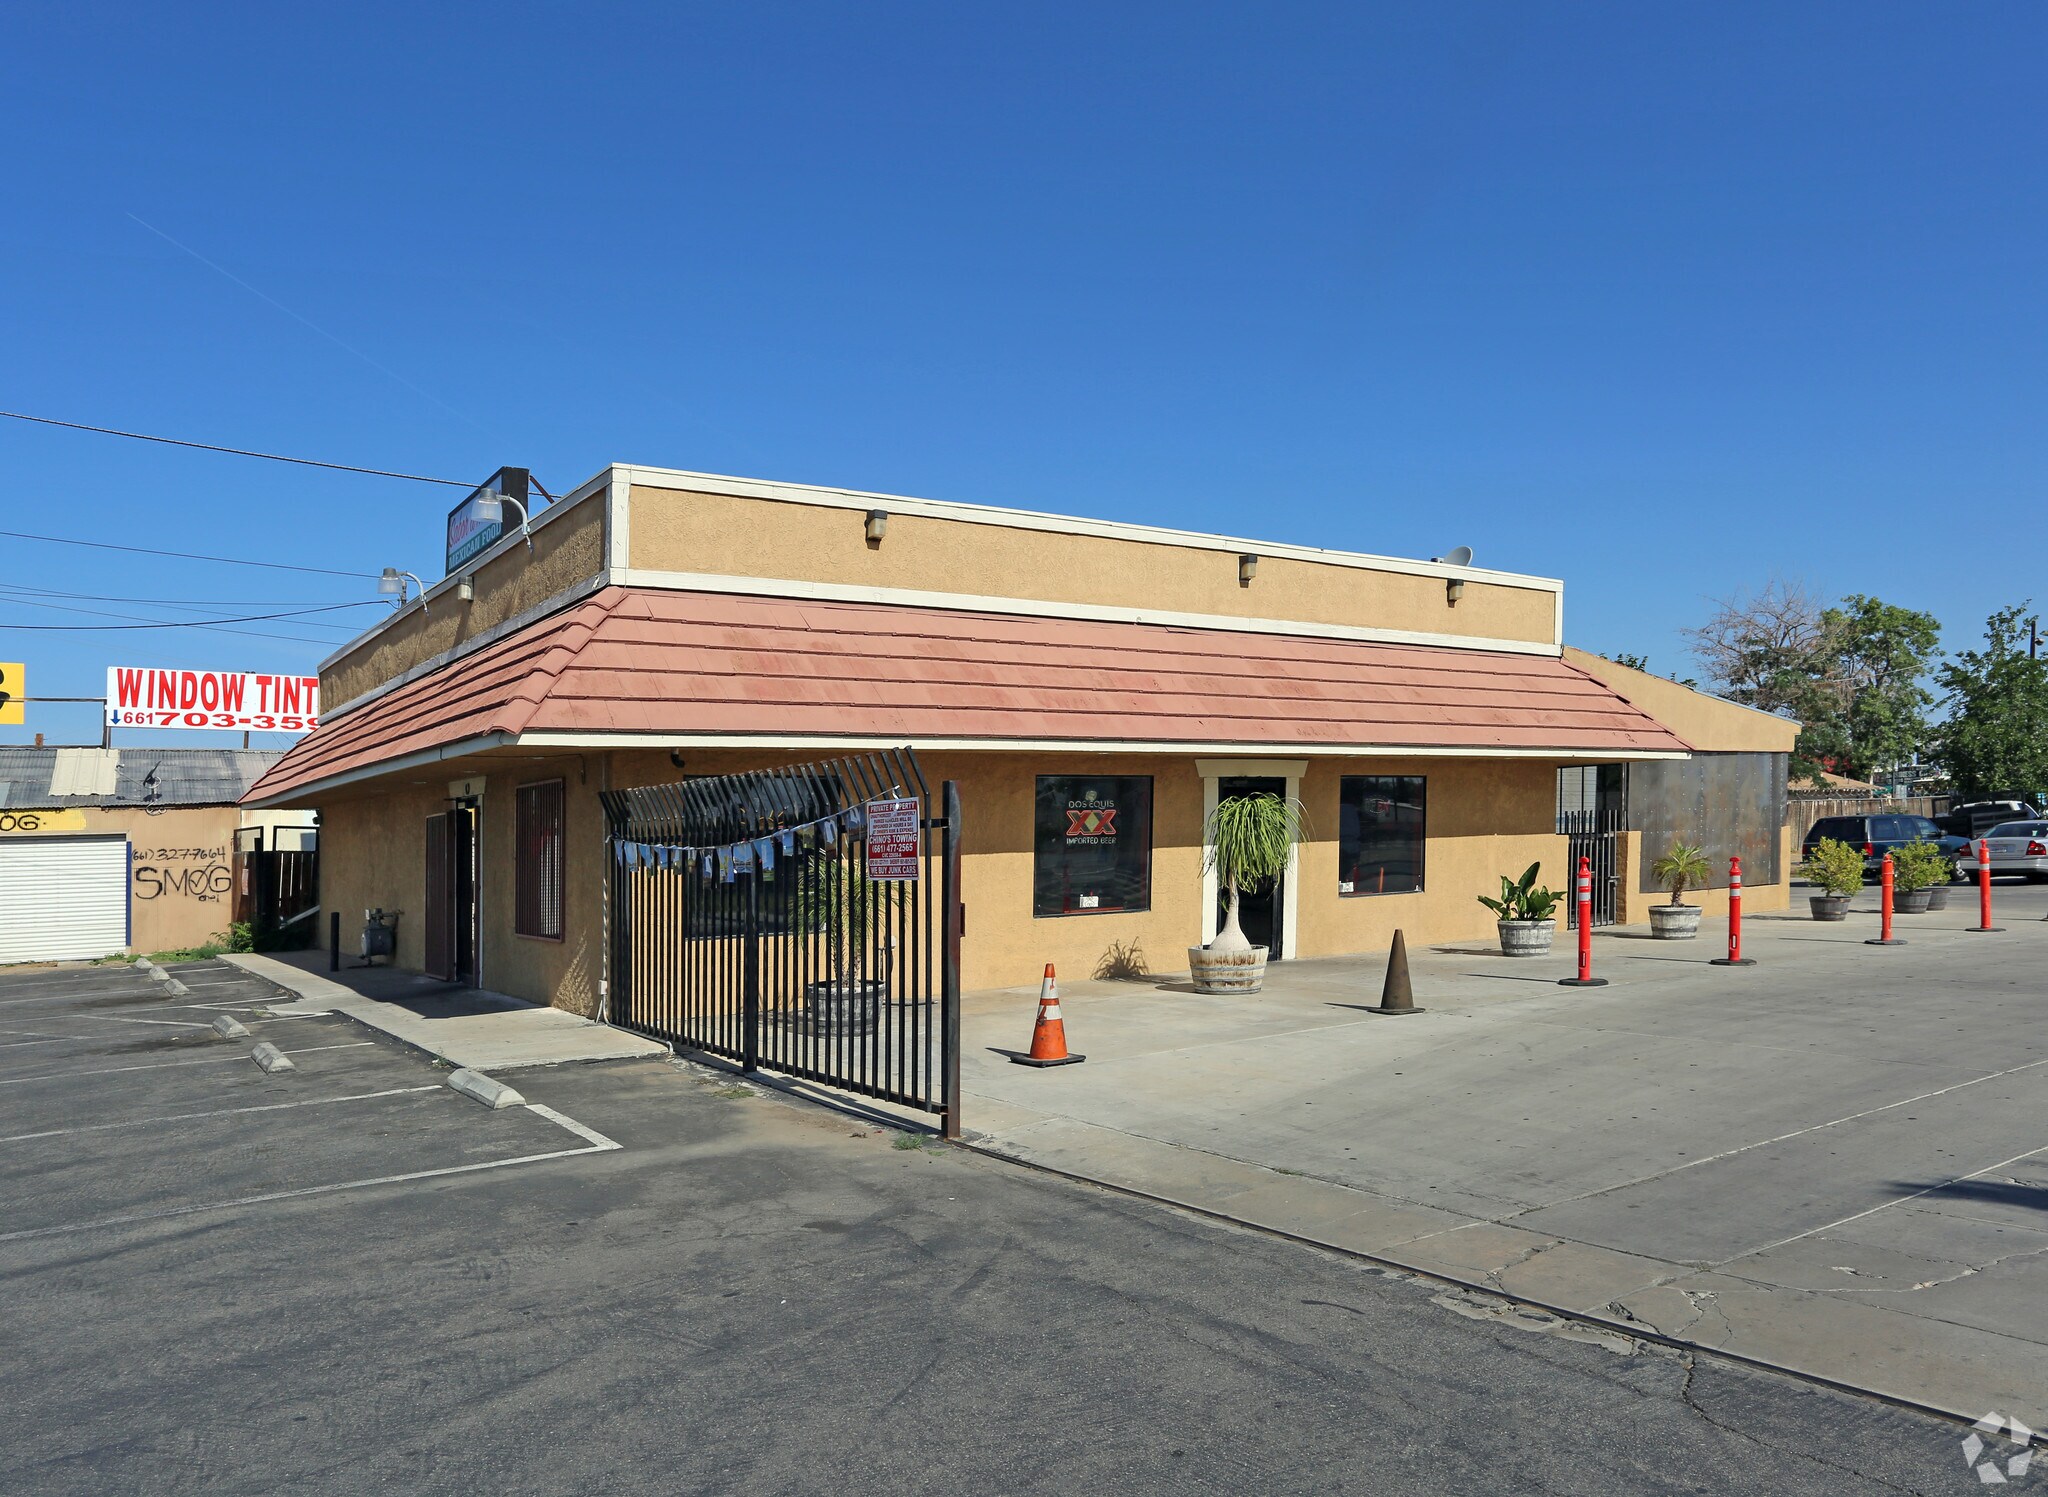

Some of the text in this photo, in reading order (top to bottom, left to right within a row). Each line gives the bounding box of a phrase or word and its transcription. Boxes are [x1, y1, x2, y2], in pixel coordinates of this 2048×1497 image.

[448, 535, 480, 570] MEXICAN
[481, 522, 502, 546] FOOD
[117, 668, 319, 714] WINDOW TINT
[123, 711, 153, 725] 661
[871, 802, 915, 812] PRIVATE PRPERTY
[1089, 800, 1114, 809] EQUIS
[1066, 809, 1117, 836] XX
[870, 834, 917, 844] CHINO'S TOWING
[1066, 836, 1116, 845] IMPORTED BEER
[131, 848, 155, 862] (661)
[878, 866, 887, 874] BUY
[888, 866, 901, 874] JUNK
[902, 866, 916, 874] CARS
[134, 862, 232, 900] SMOG
